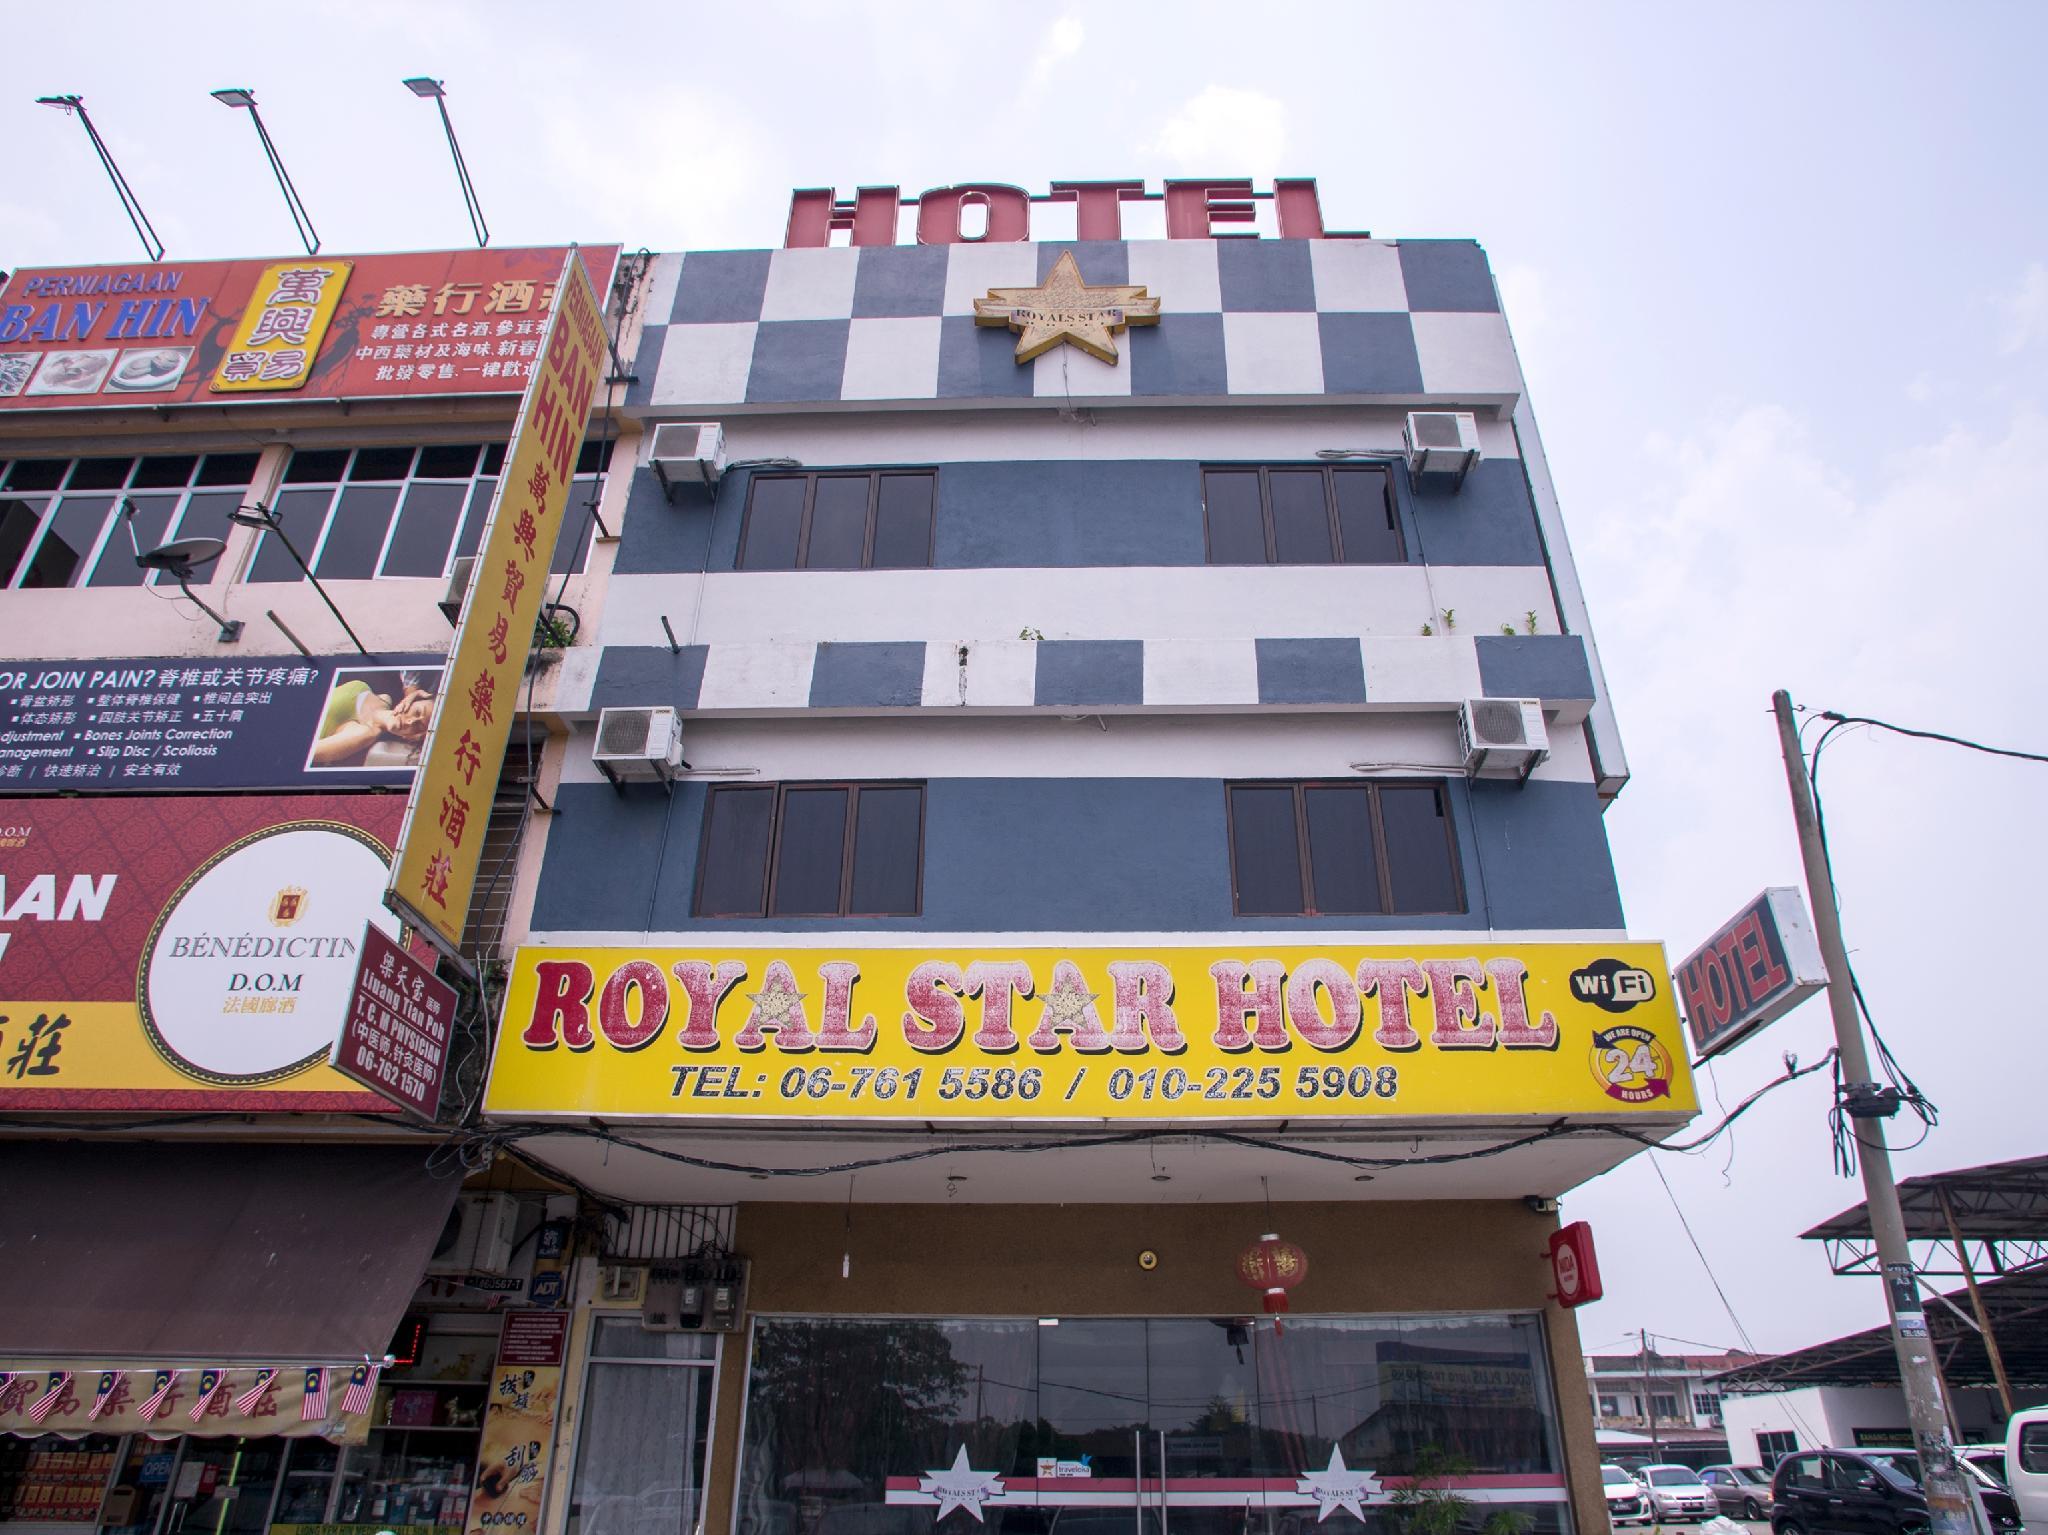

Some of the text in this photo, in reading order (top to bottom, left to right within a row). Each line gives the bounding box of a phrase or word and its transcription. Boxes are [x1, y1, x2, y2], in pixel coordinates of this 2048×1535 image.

[785, 178, 1371, 248] HOTEL
[22, 271, 183, 297] PERNIAGAAN
[0, 297, 211, 343] BAN HIN
[548, 310, 593, 430] BAN
[532, 374, 576, 487] HIN
[0, 669, 157, 689] OR JOIN PAIN?
[84, 728, 233, 741] Bones Joints Correction
[97, 745, 120, 759] Slip
[122, 746, 151, 757] Disc
[163, 744, 218, 757] Scoliosis
[0, 874, 118, 921] AN
[228, 973, 304, 991] D.O.M
[1681, 911, 1787, 1041] HOTEL
[403, 995, 425, 1024] Tian
[426, 1012, 445, 1042] Poh
[523, 957, 1560, 1054] ROYAL STAR HOTEL
[391, 1019, 441, 1066] PHYSICIAN
[1603, 1027, 1652, 1042] WE ARE OPEN
[356, 1045, 425, 1102] 06-762 1570
[670, 1064, 767, 1100] TEL:
[779, 1064, 923, 1100] 06-761
[937, 1064, 1042, 1100] 5586
[1108, 1064, 1281, 1100] 010-225
[1294, 1064, 1399, 1100] 5908
[1605, 1044, 1657, 1084] 24
[1621, 1088, 1655, 1100] HOURS
[533, 1281, 560, 1297] ADT
